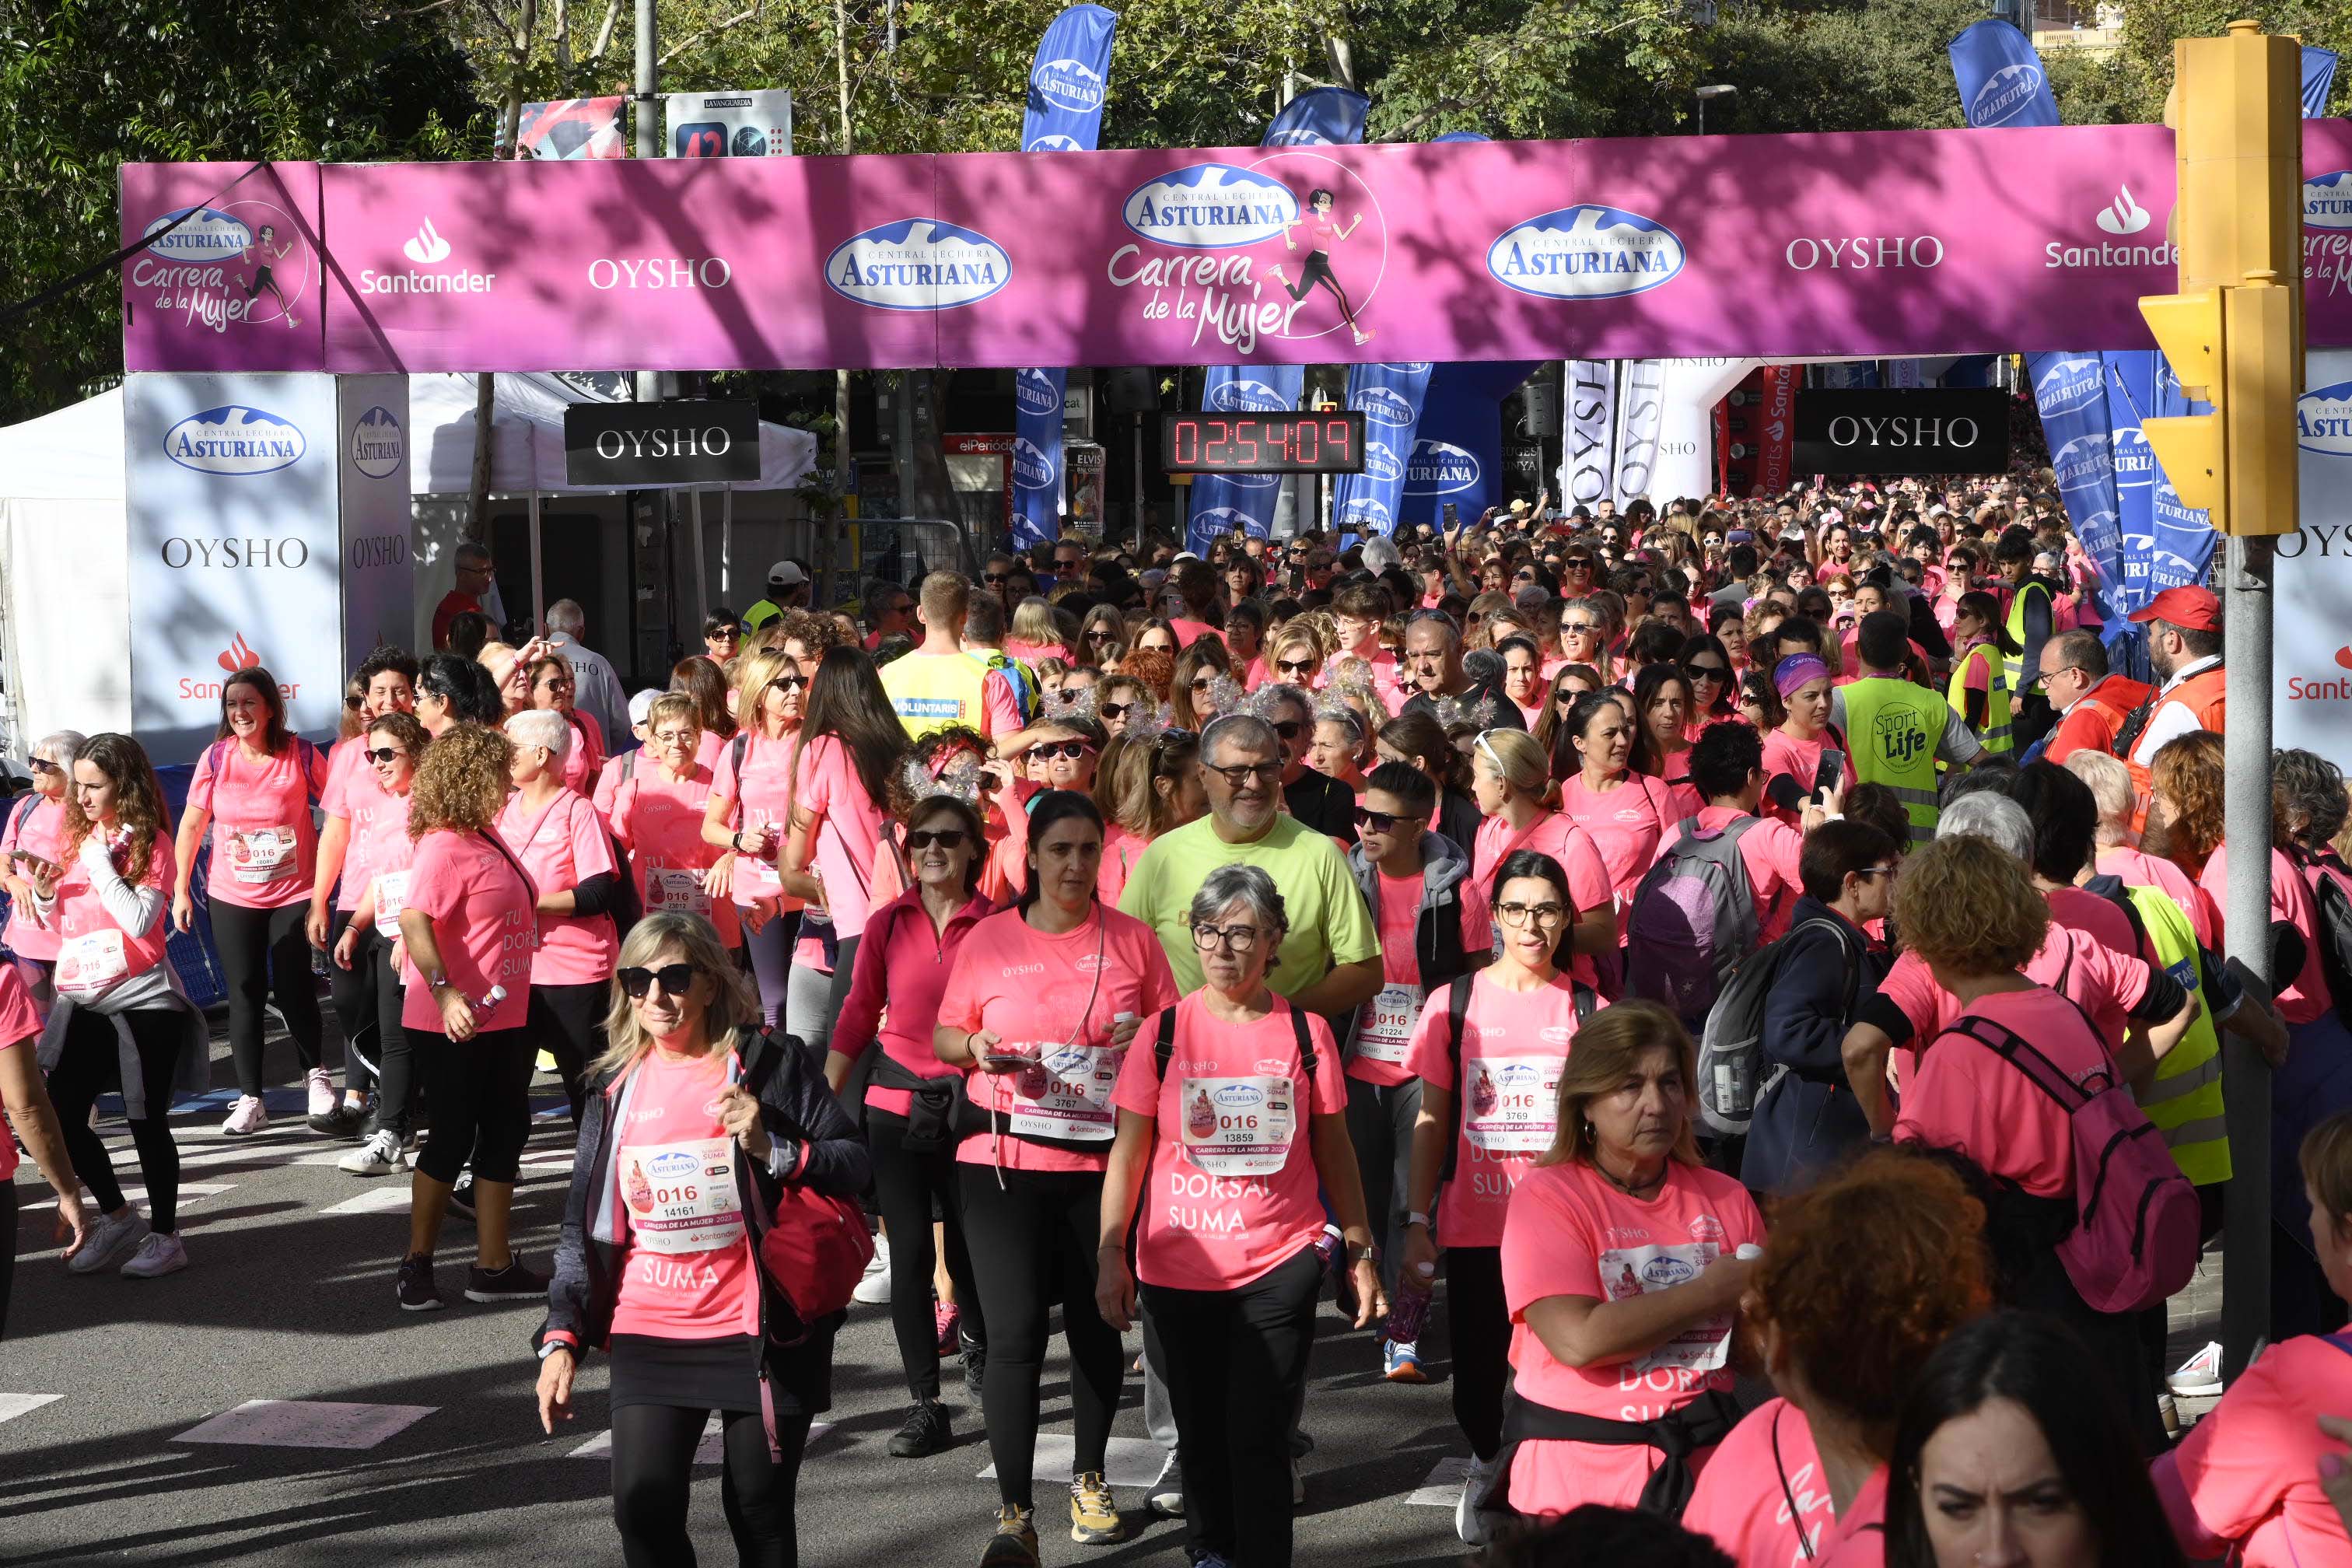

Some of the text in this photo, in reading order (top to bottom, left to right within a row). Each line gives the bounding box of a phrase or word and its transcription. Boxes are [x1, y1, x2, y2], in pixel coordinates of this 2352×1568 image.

[1041, 72, 1098, 104] ASTURIAN
[1162, 192, 1281, 202] CENTRAL LECHERA
[1136, 196, 1286, 229] ASTURIANA
[2304, 200, 2352, 215] STUR
[1532, 235, 1664, 247] CENTRAL LECHERA
[868, 250, 991, 259] CENTRAL LECHERA
[1501, 240, 1670, 276] ASTURIANA
[1786, 236, 1945, 271] OYSHO
[2046, 241, 2179, 268] Santande
[132, 258, 224, 288] Carrera
[587, 257, 731, 290] OYSHO
[839, 254, 997, 287] ASTURIANA
[1108, 243, 1253, 289] Carrera
[2318, 257, 2332, 278] la
[360, 268, 496, 296] Santander
[156, 285, 258, 334] de la Mujer
[1143, 282, 1306, 355] de la Mujer
[1017, 385, 1052, 409] TURIANA
[1770, 364, 1791, 418] Santa
[1356, 397, 1409, 423] ASTURIANA
[1572, 360, 1608, 506] OYSH
[1620, 360, 1661, 499] OYSH
[1829, 416, 1979, 448] OYSHO
[2297, 410, 2352, 438] ASTU
[174, 432, 296, 457] ASTURIANA
[355, 432, 401, 461] ASTURIANA
[596, 425, 731, 460] OYSHO
[959, 439, 1014, 452] elPeriódi
[1175, 421, 1350, 464] 02:54:09
[1660, 441, 1696, 457] SHO
[1076, 454, 1101, 464] ELVIS
[1366, 458, 1397, 478] TURIANA
[1014, 459, 1047, 483] TURIANA
[2157, 502, 2211, 527] TURIANA
[2273, 524, 2352, 558] OYS
[160, 537, 309, 569] OYSHO
[352, 534, 405, 569] OYSHO
[178, 677, 301, 700] Saner
[2287, 677, 2352, 701] Sant
[893, 702, 957, 714] VOLUNTARIS
[1875, 710, 1919, 735] Sport
[1884, 727, 1927, 761] Life
[644, 803, 671, 814] OYSHO
[645, 856, 664, 869] TU
[667, 892, 689, 901] 016
[506, 908, 523, 926] TU
[503, 930, 534, 951] DORS
[502, 957, 531, 975] SUM
[1003, 963, 1045, 978] OYSHO
[1377, 994, 1410, 1004] ASTURIANA
[1377, 1013, 1407, 1026] 016
[1380, 1027, 1402, 1036] 21224
[1464, 1027, 1506, 1038] OYSHO
[1359, 1045, 1381, 1054] OYSHO
[1050, 1058, 1090, 1071] ASTURIANA
[1178, 1059, 1219, 1073] OYSHO
[1498, 1073, 1537, 1083] ASTURIANA
[1050, 1081, 1085, 1097] 016
[1217, 1092, 1261, 1103] ASTURIANA
[1055, 1098, 1077, 1108] 3767
[1502, 1094, 1535, 1108] 016
[628, 1107, 665, 1123] YSHO
[1024, 1107, 1052, 1117] CARRERA
[1506, 1111, 1528, 1120] 3769
[1020, 1119, 1107, 1134] OYSHO Santander
[1220, 1115, 1258, 1129] 016
[1224, 1132, 1255, 1143] 13859
[1472, 1134, 1506, 1144] OYSHO
[702, 1152, 726, 1160] SUMA
[1195, 1146, 1226, 1154] CARRERA
[651, 1161, 695, 1174] ASTURIANA
[656, 1185, 698, 1204] 016
[663, 1206, 695, 1218] 14161
[1168, 1205, 1247, 1233] SUMA
[644, 1220, 667, 1230] CARRERA
[690, 1218, 714, 1227] MUJER
[699, 1229, 738, 1242] Santander
[642, 1256, 719, 1290] SUMA
